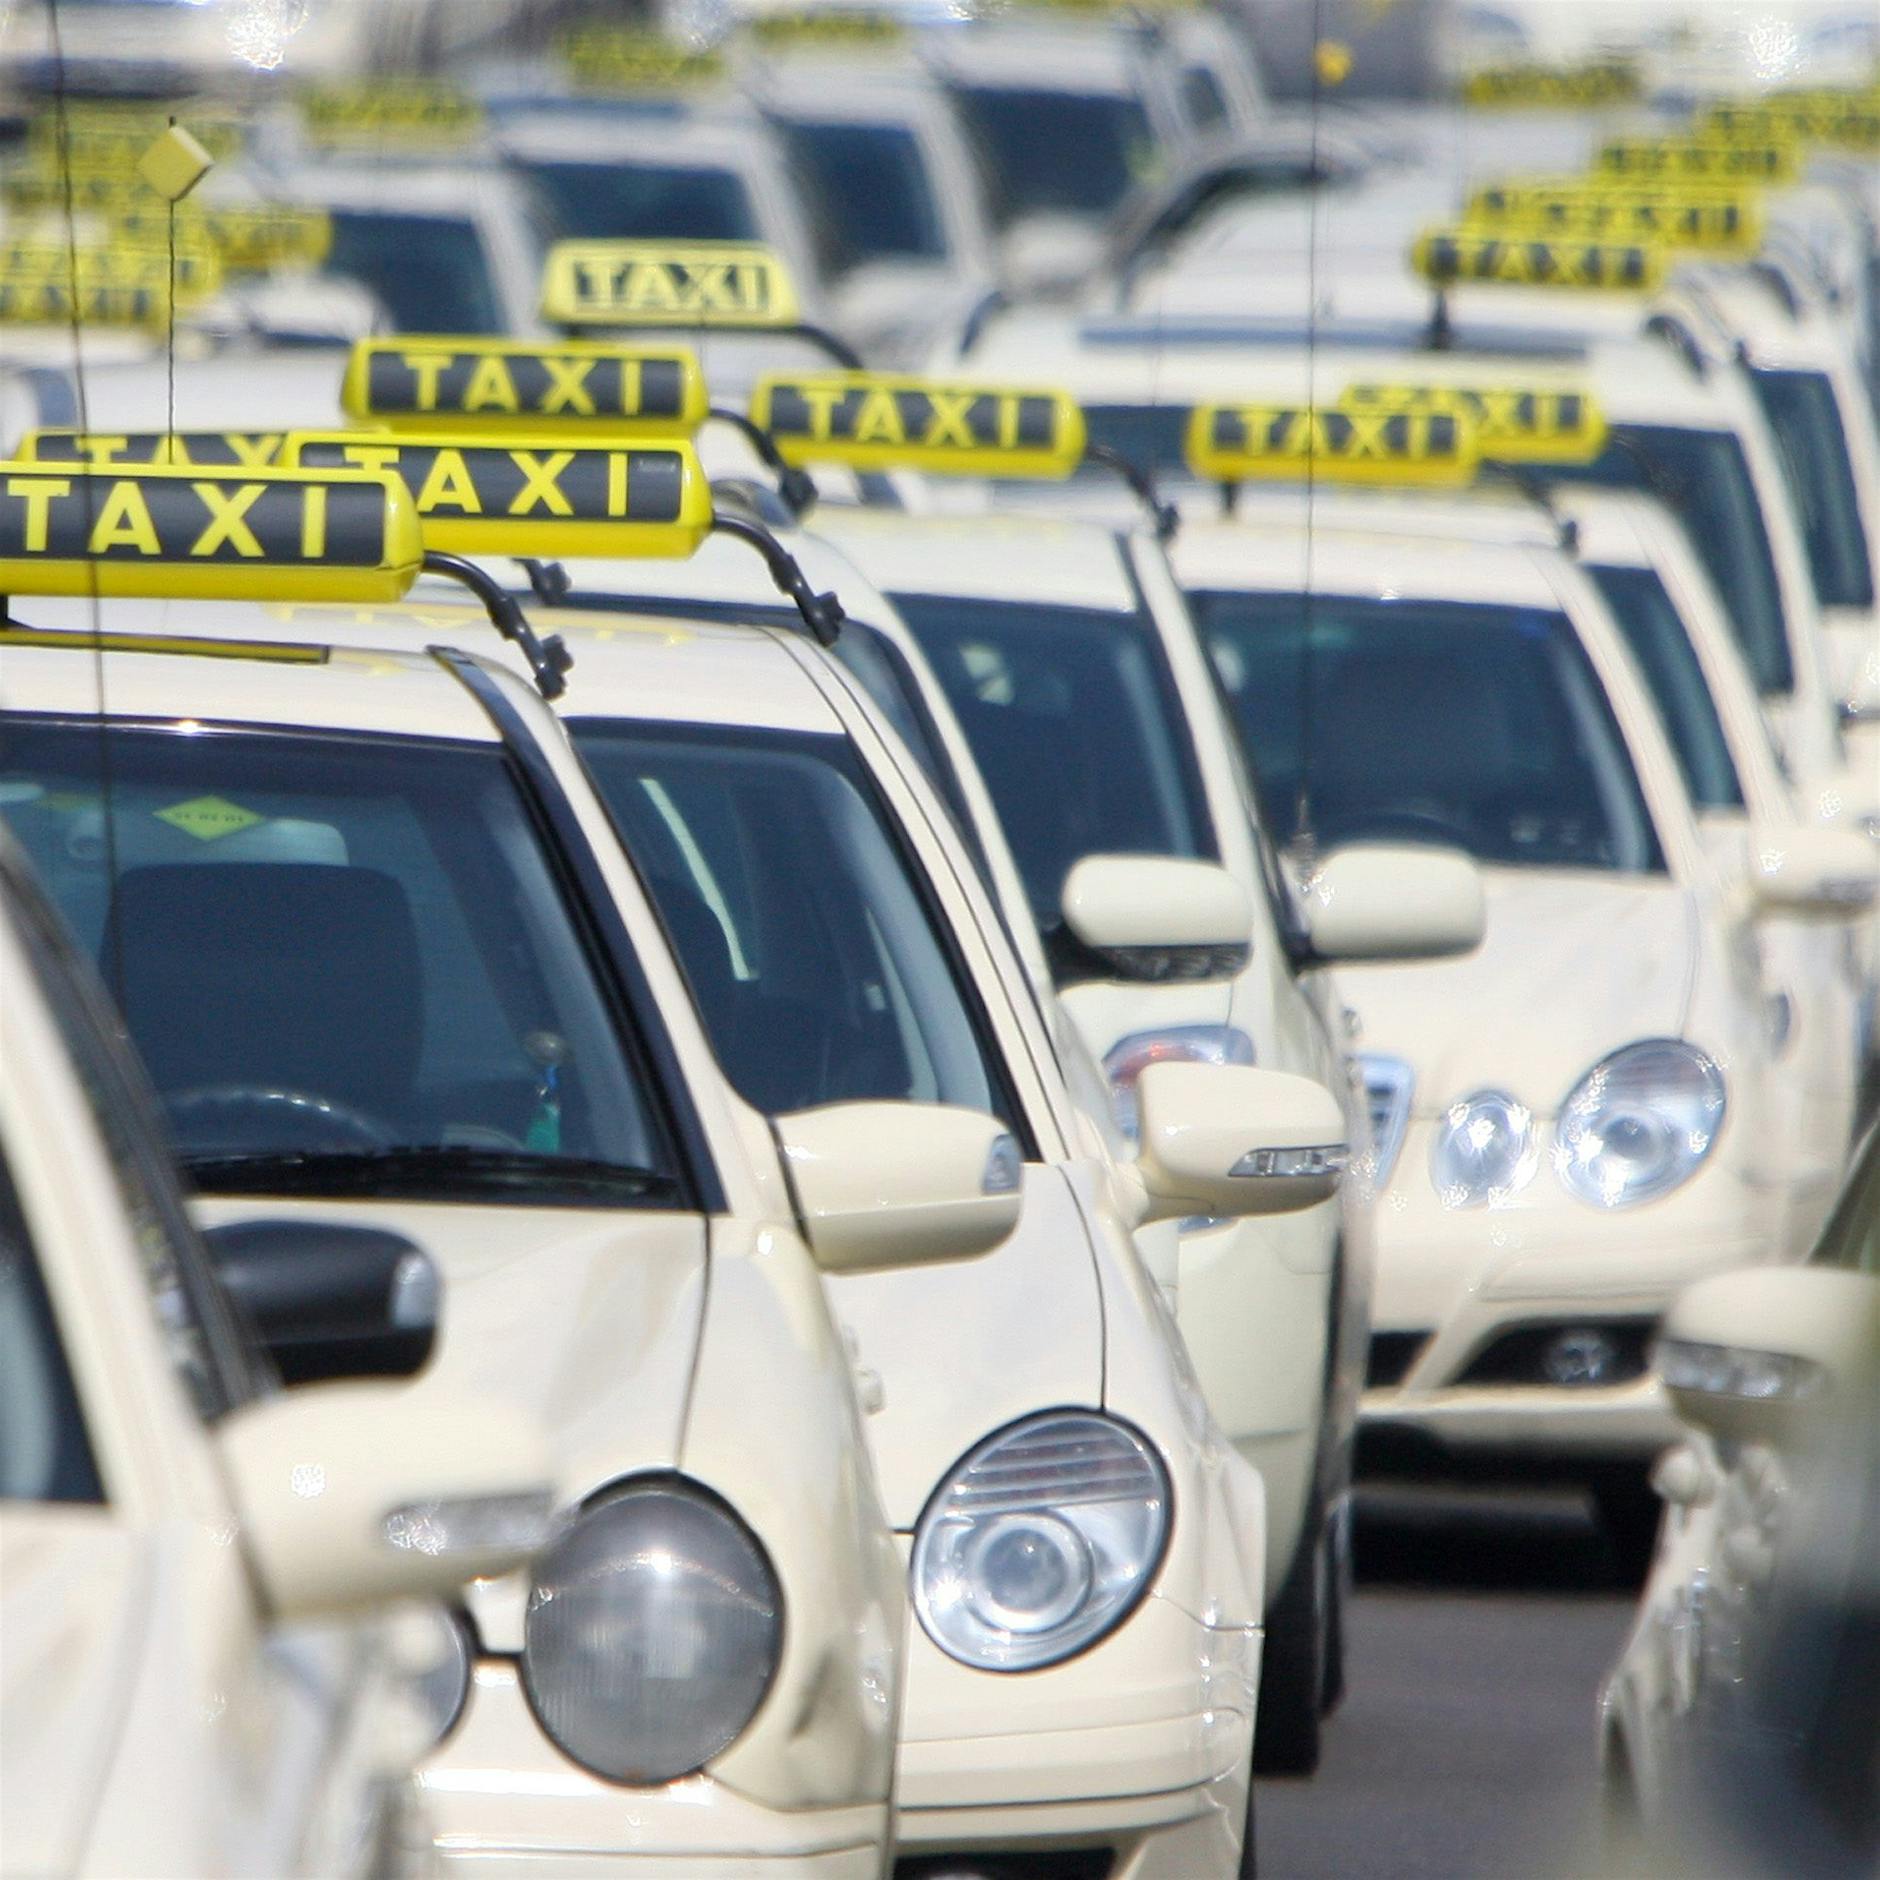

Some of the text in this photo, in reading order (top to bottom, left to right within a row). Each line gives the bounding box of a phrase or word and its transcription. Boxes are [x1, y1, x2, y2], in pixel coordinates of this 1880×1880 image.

[573, 261, 762, 312] TAXI
[403, 353, 642, 416] TAXI
[802, 388, 1020, 448] TAXI
[1237, 410, 1430, 459] TAXI
[7, 478, 328, 558] TAXI
